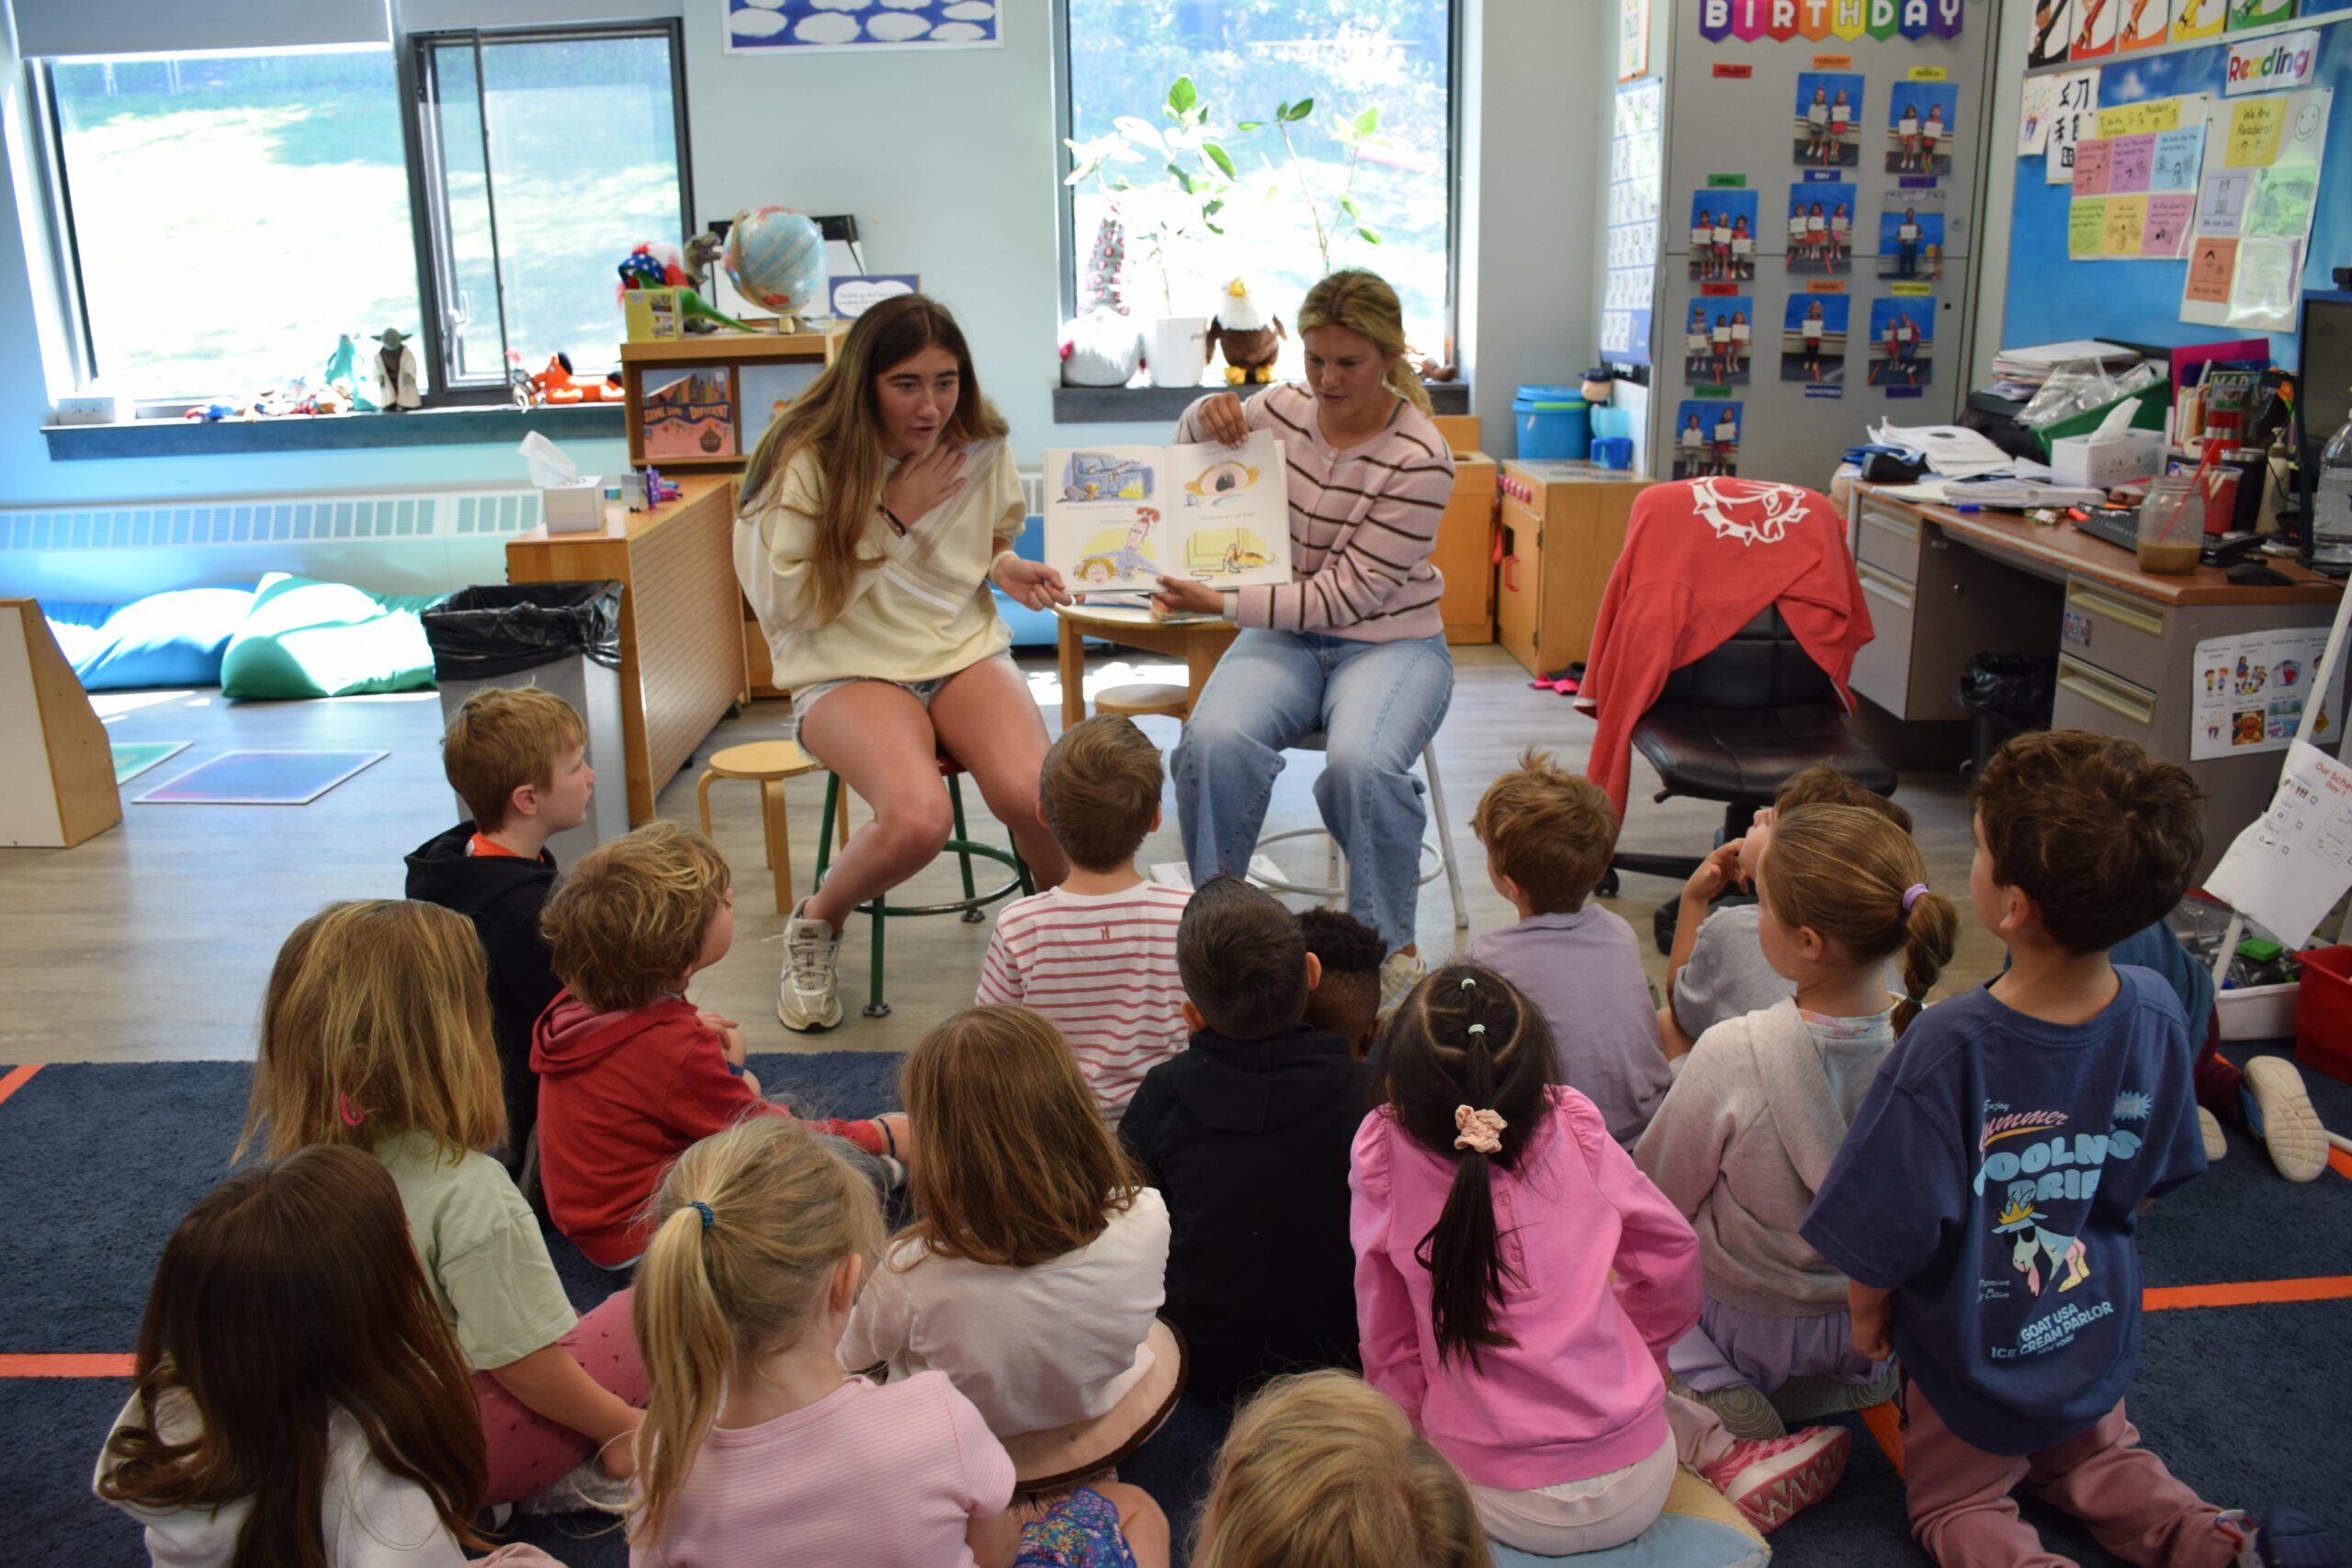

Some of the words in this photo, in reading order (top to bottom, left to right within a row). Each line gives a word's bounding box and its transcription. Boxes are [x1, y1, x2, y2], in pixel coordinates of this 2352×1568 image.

[1705, 0, 1959, 28] BIRTHDAY
[2228, 46, 2309, 84] Reading
[2315, 762, 2330, 775] Our
[2325, 780, 2339, 794] Day
[1984, 1099, 2010, 1112] Enjoy
[1991, 1347, 2017, 1359] ICE
[2020, 1330, 2064, 1355] CREAM
[2062, 1302, 2114, 1334] PARLOR
[2021, 1315, 2052, 1341] GOAT
[2053, 1303, 2078, 1323] USA
